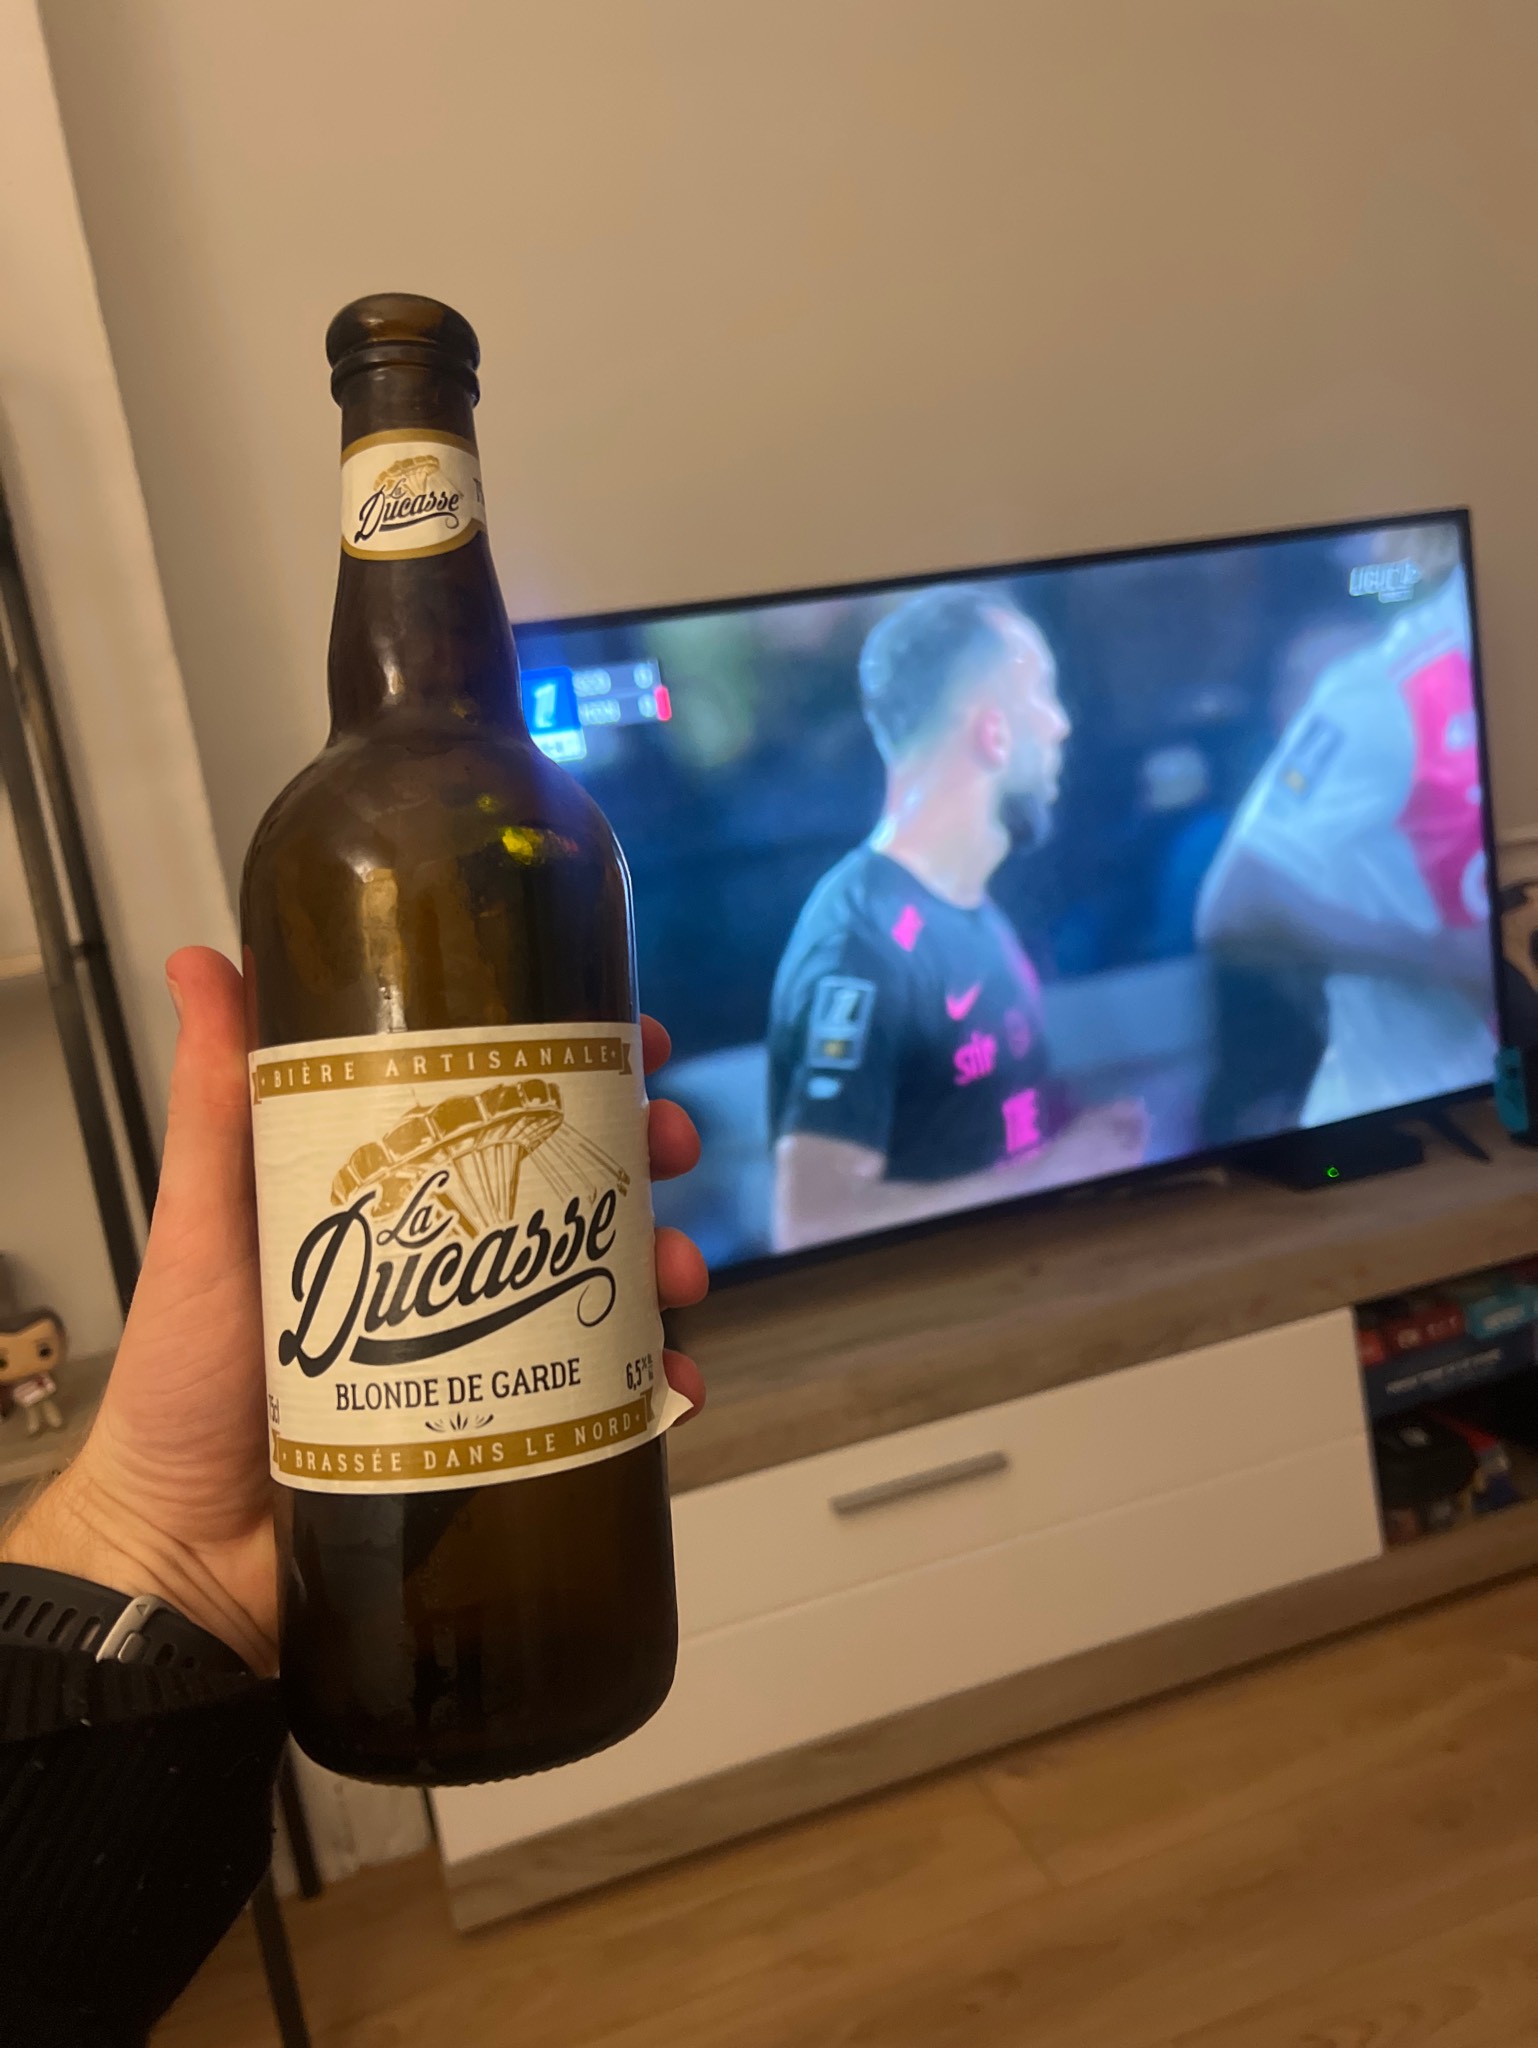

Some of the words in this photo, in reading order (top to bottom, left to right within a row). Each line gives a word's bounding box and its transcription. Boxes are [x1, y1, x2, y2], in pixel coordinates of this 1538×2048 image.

[354, 485, 460, 544] Ducasse
[273, 1061, 355, 1089] BIÈRE
[385, 1045, 609, 1078] ARTISANALE
[375, 1169, 459, 1250] La
[278, 1188, 617, 1378] Ducasse
[335, 1378, 439, 1412] BLONDE
[447, 1375, 484, 1402] DE
[491, 1357, 582, 1397] GARDE
[295, 1446, 402, 1474] BRASSÉE
[423, 1441, 505, 1470] DANS
[525, 1431, 557, 1456] LE
[574, 1416, 633, 1446] NORD
